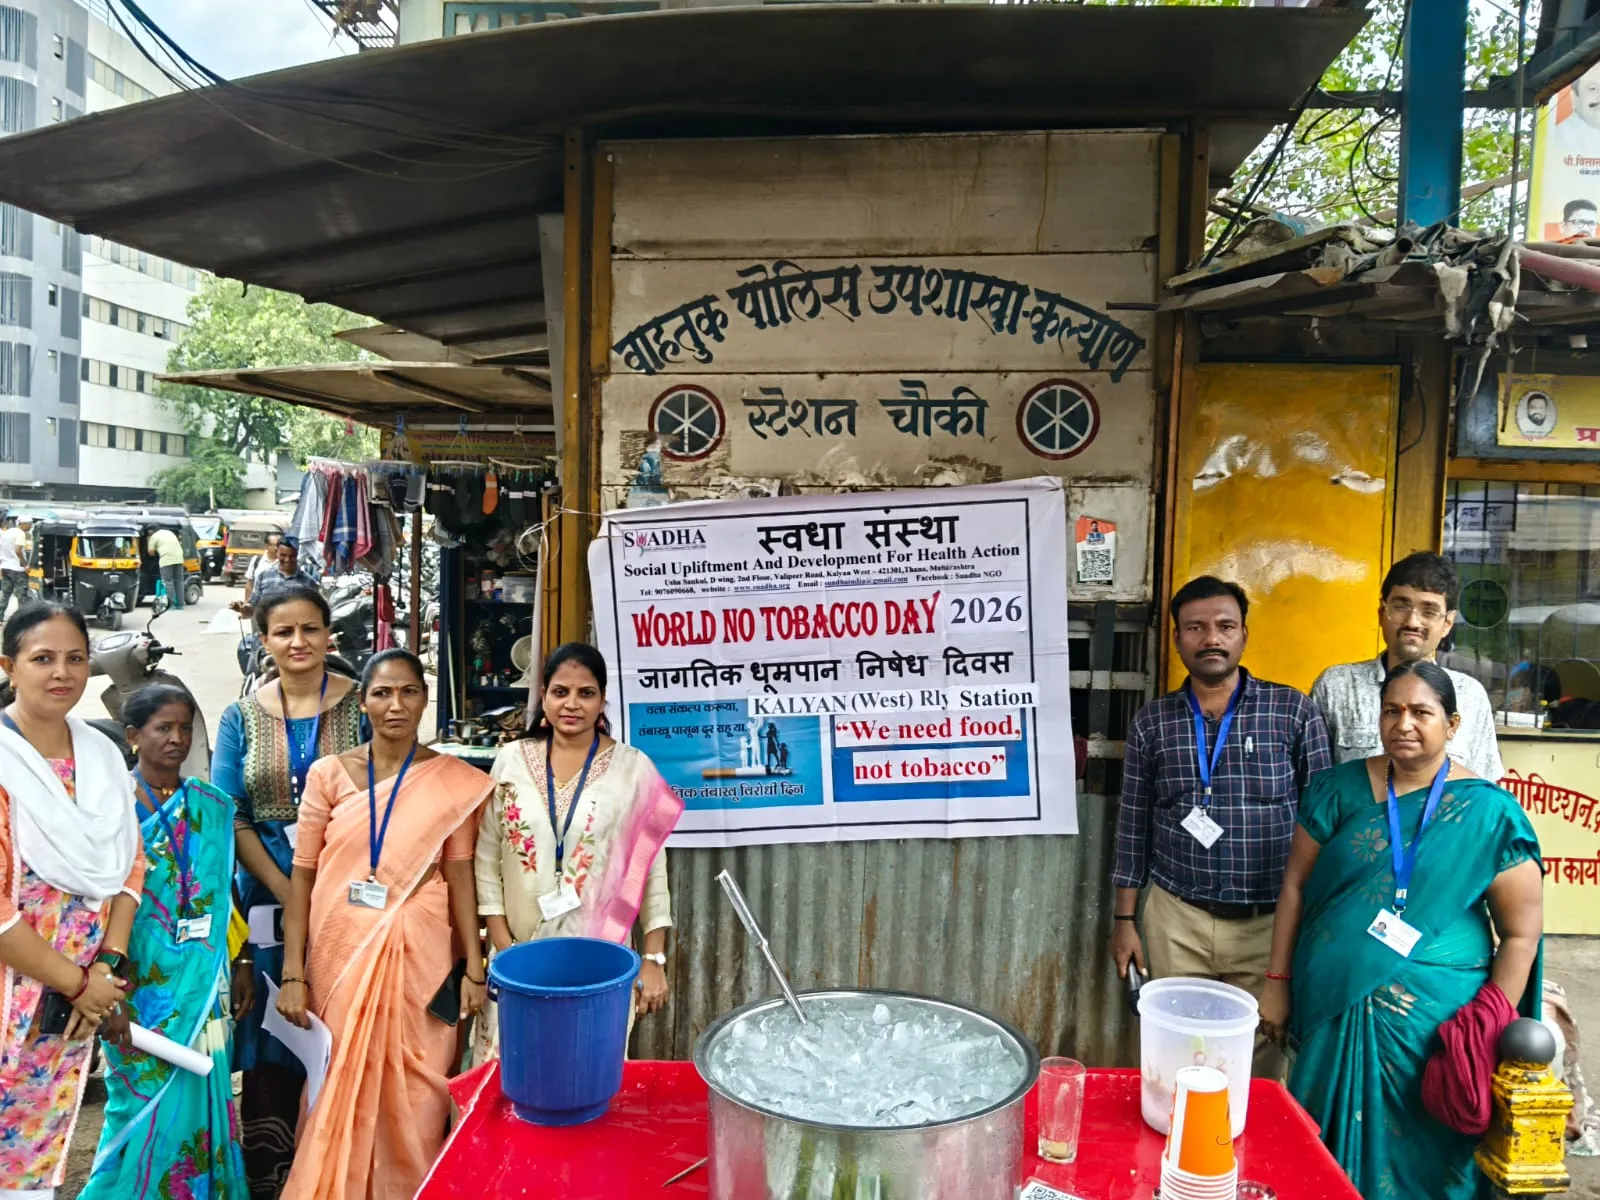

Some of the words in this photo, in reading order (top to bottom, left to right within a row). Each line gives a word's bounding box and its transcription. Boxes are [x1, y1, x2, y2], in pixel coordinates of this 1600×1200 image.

[612, 294, 729, 376] वाहतुक
[725, 260, 864, 331] पोलिस
[742, 387, 859, 440] स्टेशन
[878, 379, 990, 439] चौकी
[757, 522, 846, 555] स्वधा
[864, 508, 960, 549] संस्था
[624, 562, 667, 577] Social
[671, 558, 748, 577] Upliftment
[753, 556, 783, 570] And
[788, 551, 882, 570] Development
[887, 550, 913, 564] For
[918, 547, 966, 562] Health
[971, 544, 1020, 558] Action
[737, 575, 750, 583] 2nd
[805, 571, 824, 580] Road,
[826, 569, 851, 579] Kalyan
[853, 568, 870, 576] West
[798, 580, 818, 588] Email
[916, 572, 949, 582] Facebook
[983, 570, 1002, 579] NGO
[631, 604, 717, 648] WORLD
[722, 608, 756, 643] NO
[759, 600, 878, 641] TOBACCO
[884, 590, 941, 635] DAY
[951, 595, 1023, 624] 2026
[638, 658, 745, 689] जागतिक
[750, 658, 841, 694] धूम्रपान
[855, 650, 929, 679] निषेध
[943, 647, 1014, 677] दिवस
[754, 694, 847, 715] KALYAN
[851, 690, 913, 713] (West)
[919, 688, 948, 711] Rly
[960, 687, 1034, 708] Station
[638, 724, 671, 739] तंबाखू
[672, 725, 699, 738] पासून
[701, 725, 714, 739] दूर
[835, 719, 891, 741] “We
[898, 717, 952, 739] need
[960, 714, 1022, 739] food,
[854, 761, 892, 780] not
[901, 753, 1005, 778] tobacco”
[700, 783, 740, 802] तंबाखू
[740, 781, 778, 797] विरोधी
[780, 781, 804, 796] दिन
